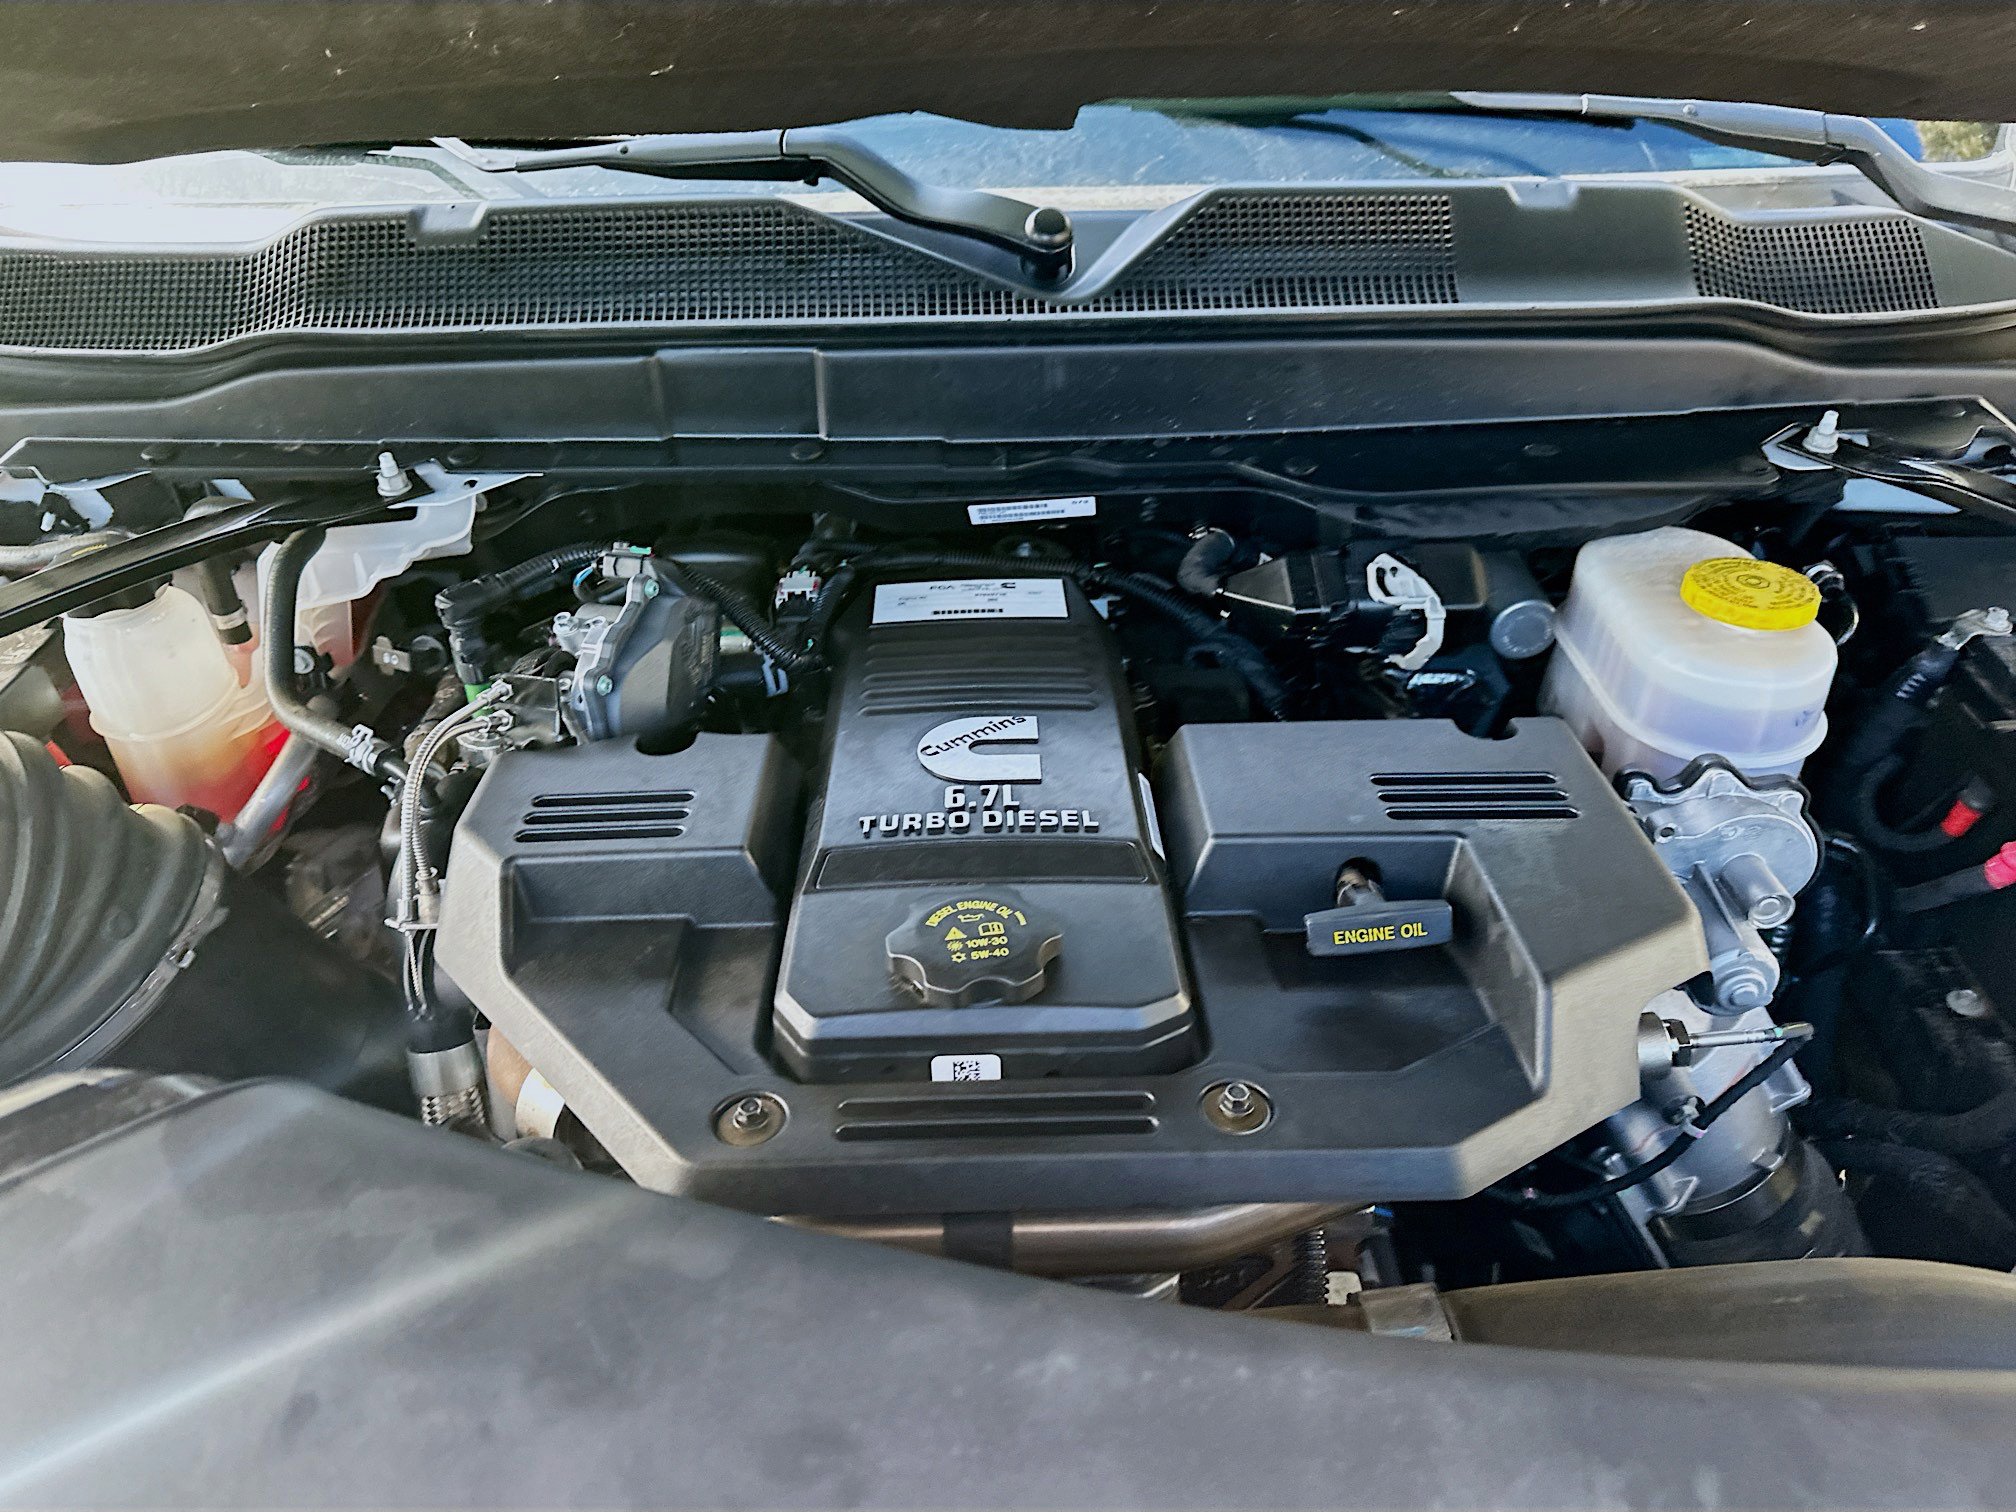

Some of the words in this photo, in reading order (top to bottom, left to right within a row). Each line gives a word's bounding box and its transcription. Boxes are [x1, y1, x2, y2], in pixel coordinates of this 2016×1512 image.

[920, 716, 1027, 757] Cummins
[944, 784, 1020, 809] 6.7L
[858, 811, 971, 837] TURBO
[982, 809, 1100, 833] DIESEL
[956, 900, 999, 911] ENGINE
[996, 906, 1013, 919] OIL
[965, 936, 1008, 948] 10W-30
[1332, 925, 1396, 945] ENGINE
[1400, 922, 1429, 938] OIL
[970, 947, 1010, 960] 5W-40
